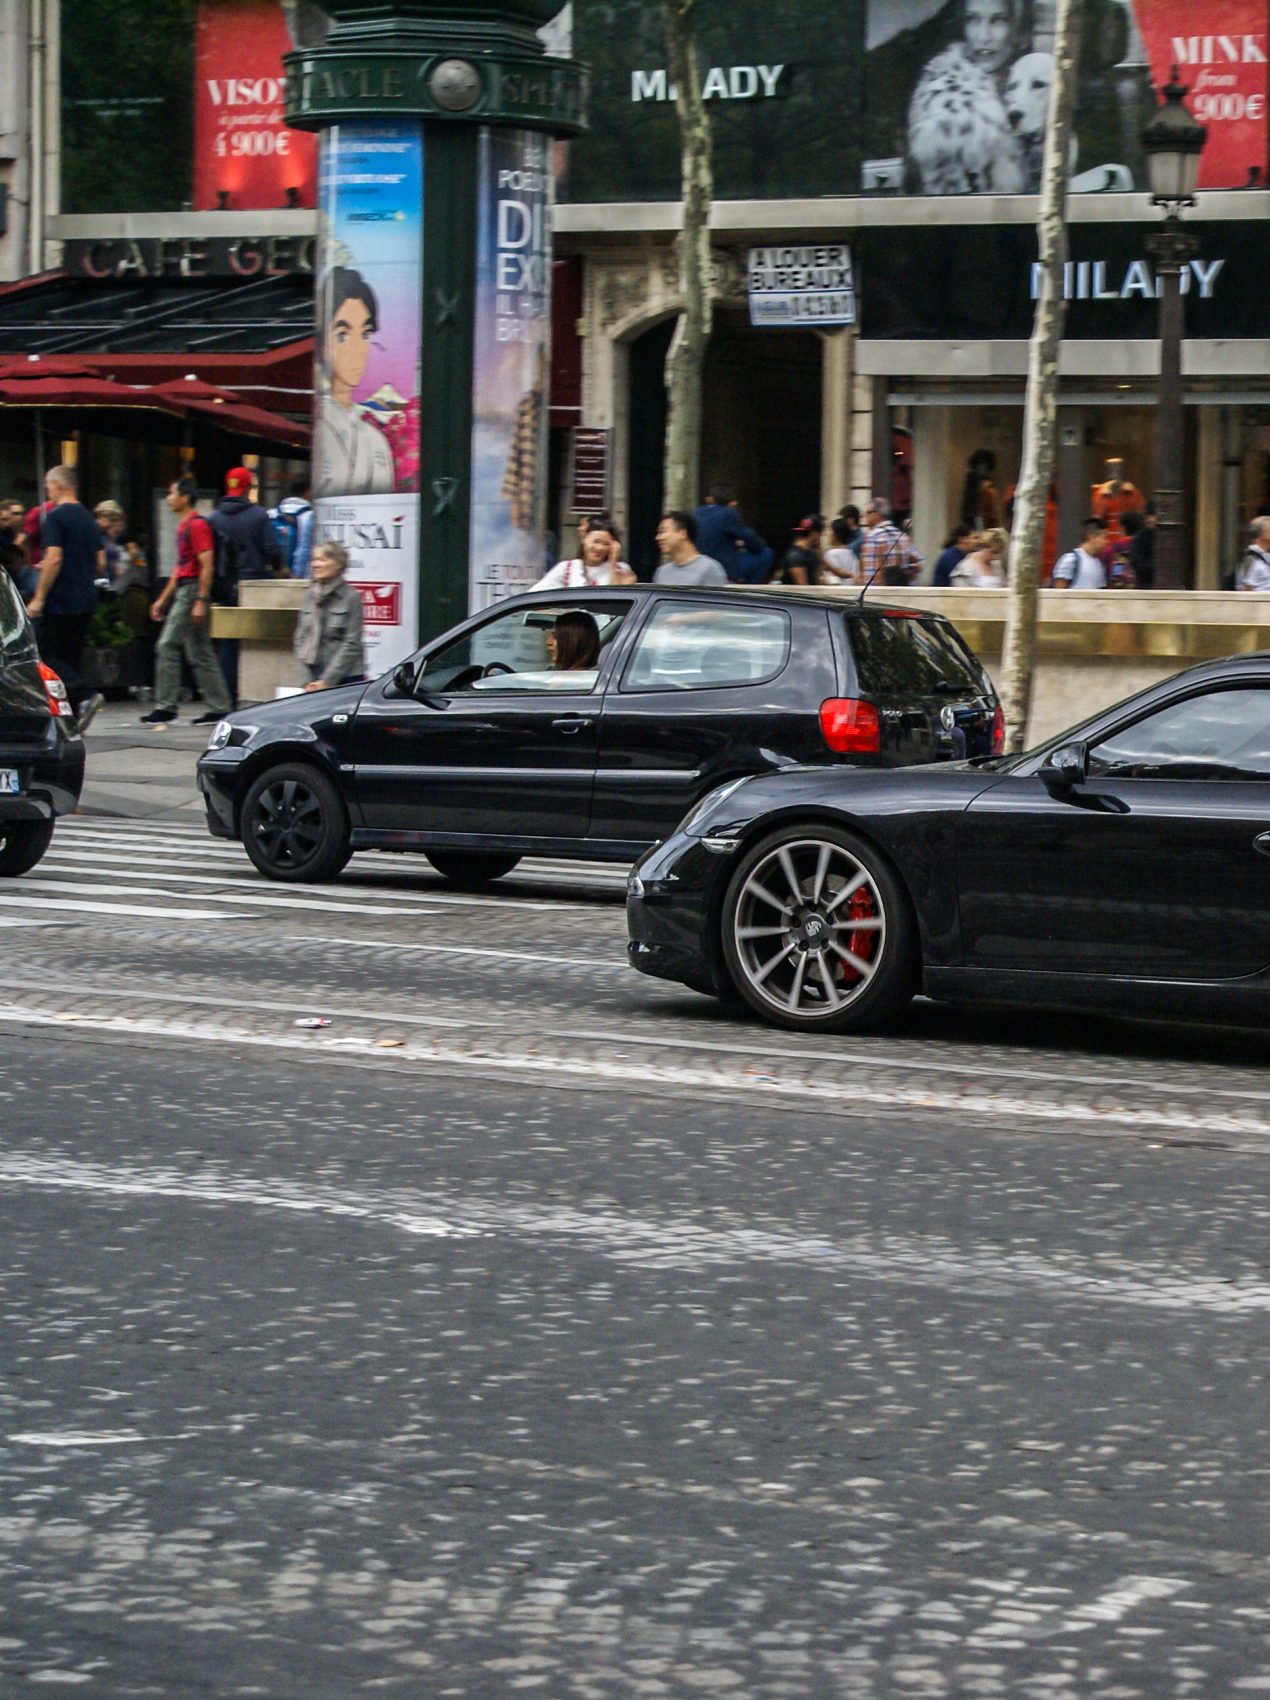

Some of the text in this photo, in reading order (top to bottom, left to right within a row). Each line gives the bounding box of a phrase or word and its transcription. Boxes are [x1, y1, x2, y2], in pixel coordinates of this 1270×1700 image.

[1171, 34, 1268, 64] MINK
[631, 64, 785, 101] MADY
[1193, 93, 1266, 120] 900€
[211, 132, 227, 156] 4
[230, 131, 292, 156] 900€
[497, 200, 543, 250] DI
[773, 246, 843, 269] LOUER
[752, 268, 853, 291] BUREAUX
